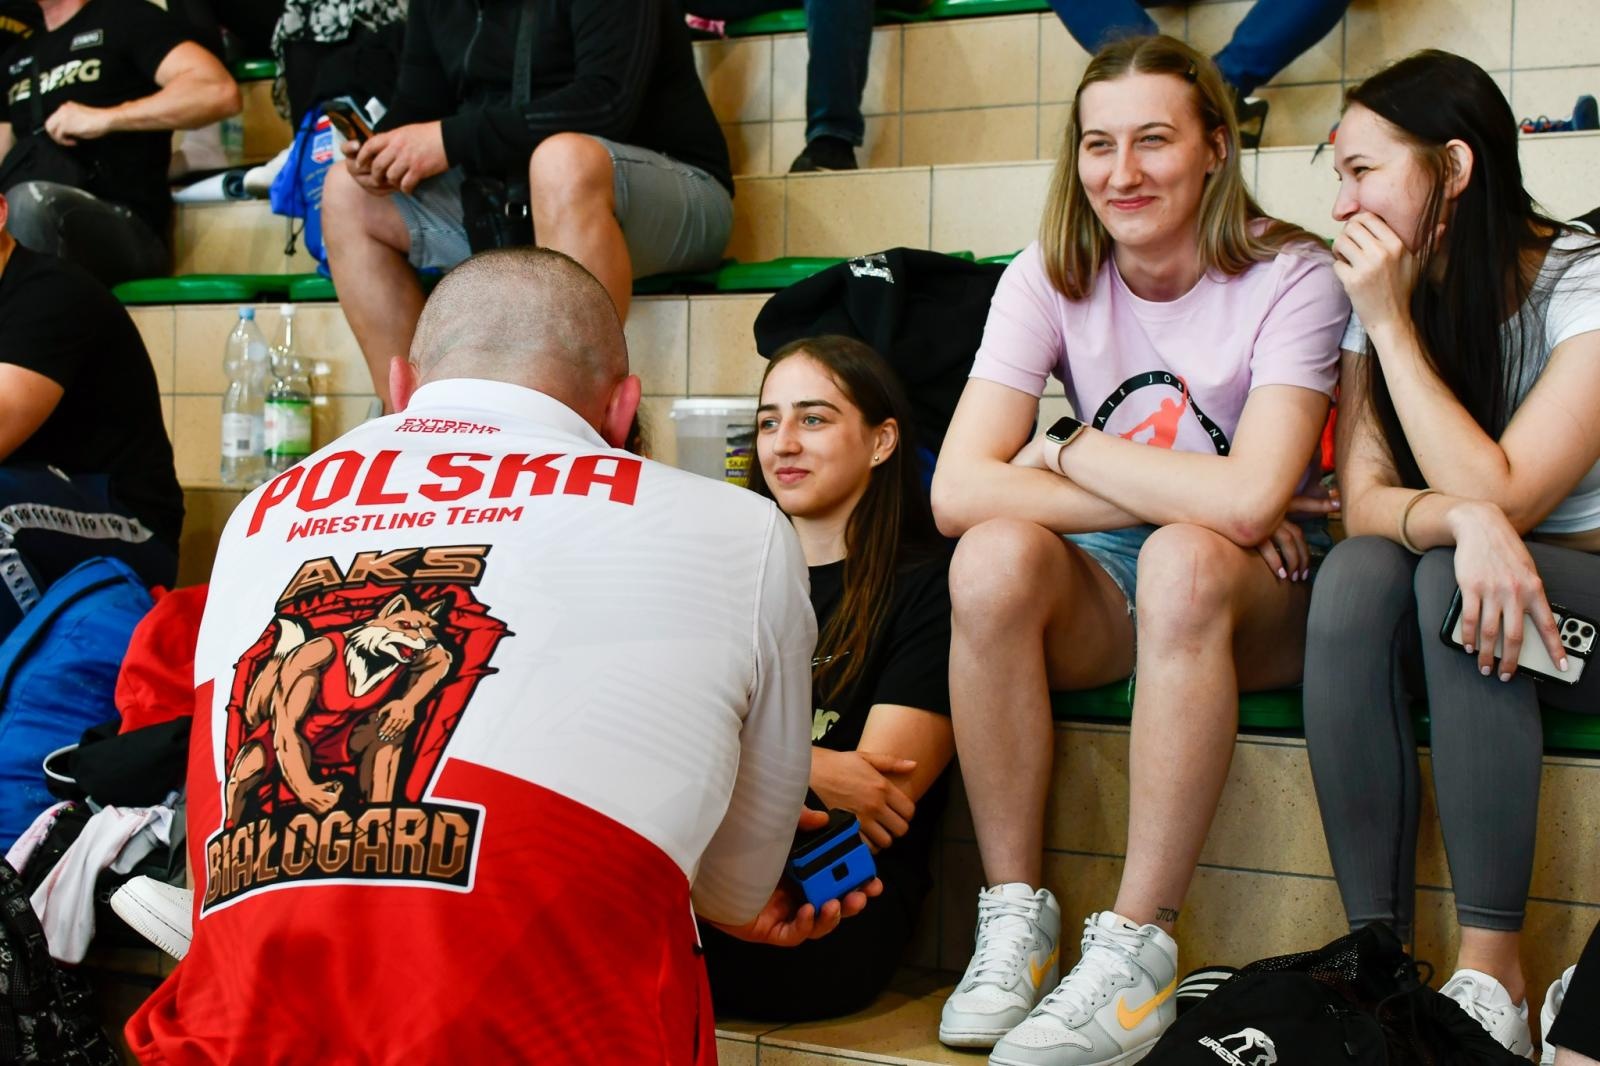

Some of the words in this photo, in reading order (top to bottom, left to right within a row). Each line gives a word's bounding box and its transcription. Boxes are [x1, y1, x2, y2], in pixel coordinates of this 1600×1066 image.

[1097, 388, 1126, 424] AIR
[1148, 374, 1220, 438] JORAN
[246, 449, 643, 538] POLSKA
[286, 509, 436, 543] WRESTLING
[447, 505, 525, 526] TEAM
[276, 545, 492, 606] AKS
[204, 807, 471, 906] BIAŁOGARD
